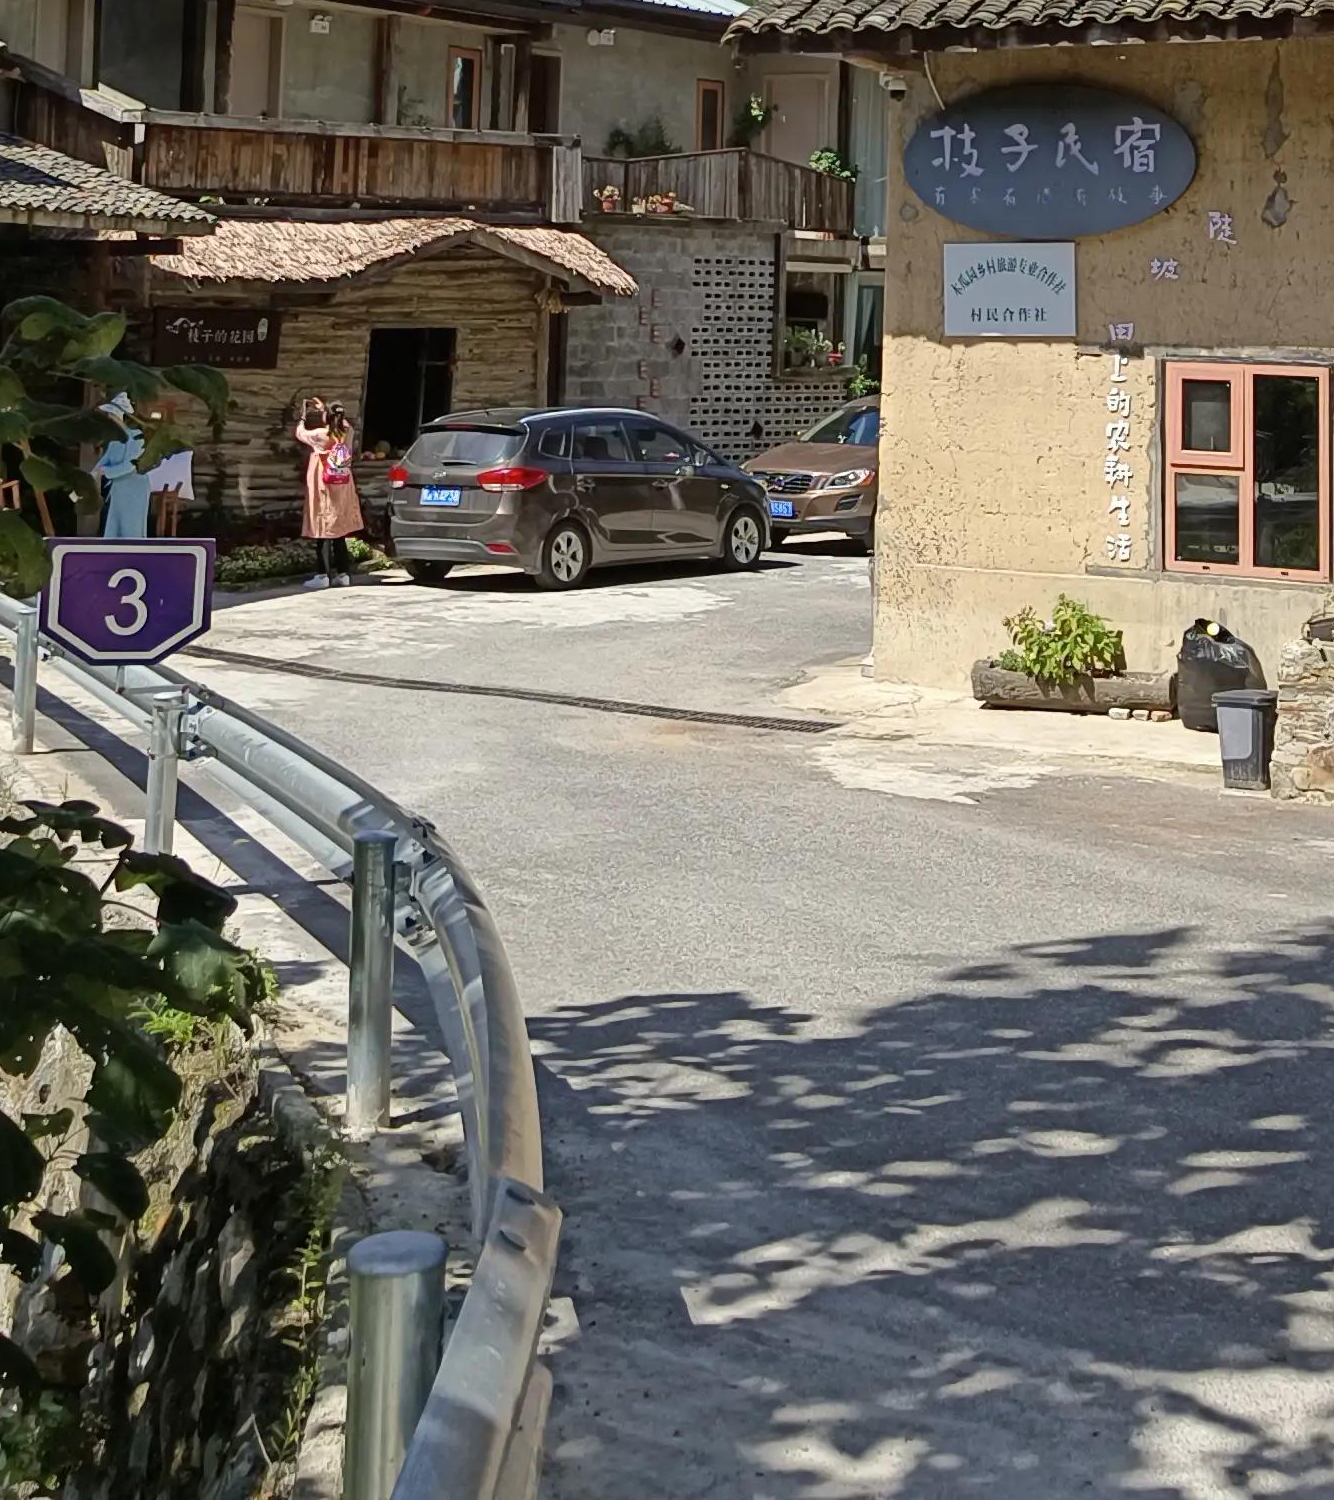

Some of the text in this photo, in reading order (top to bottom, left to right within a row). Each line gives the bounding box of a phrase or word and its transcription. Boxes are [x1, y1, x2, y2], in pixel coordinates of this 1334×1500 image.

[970, 307, 1049, 322] 村民合作社
[104, 568, 148, 636] 3
